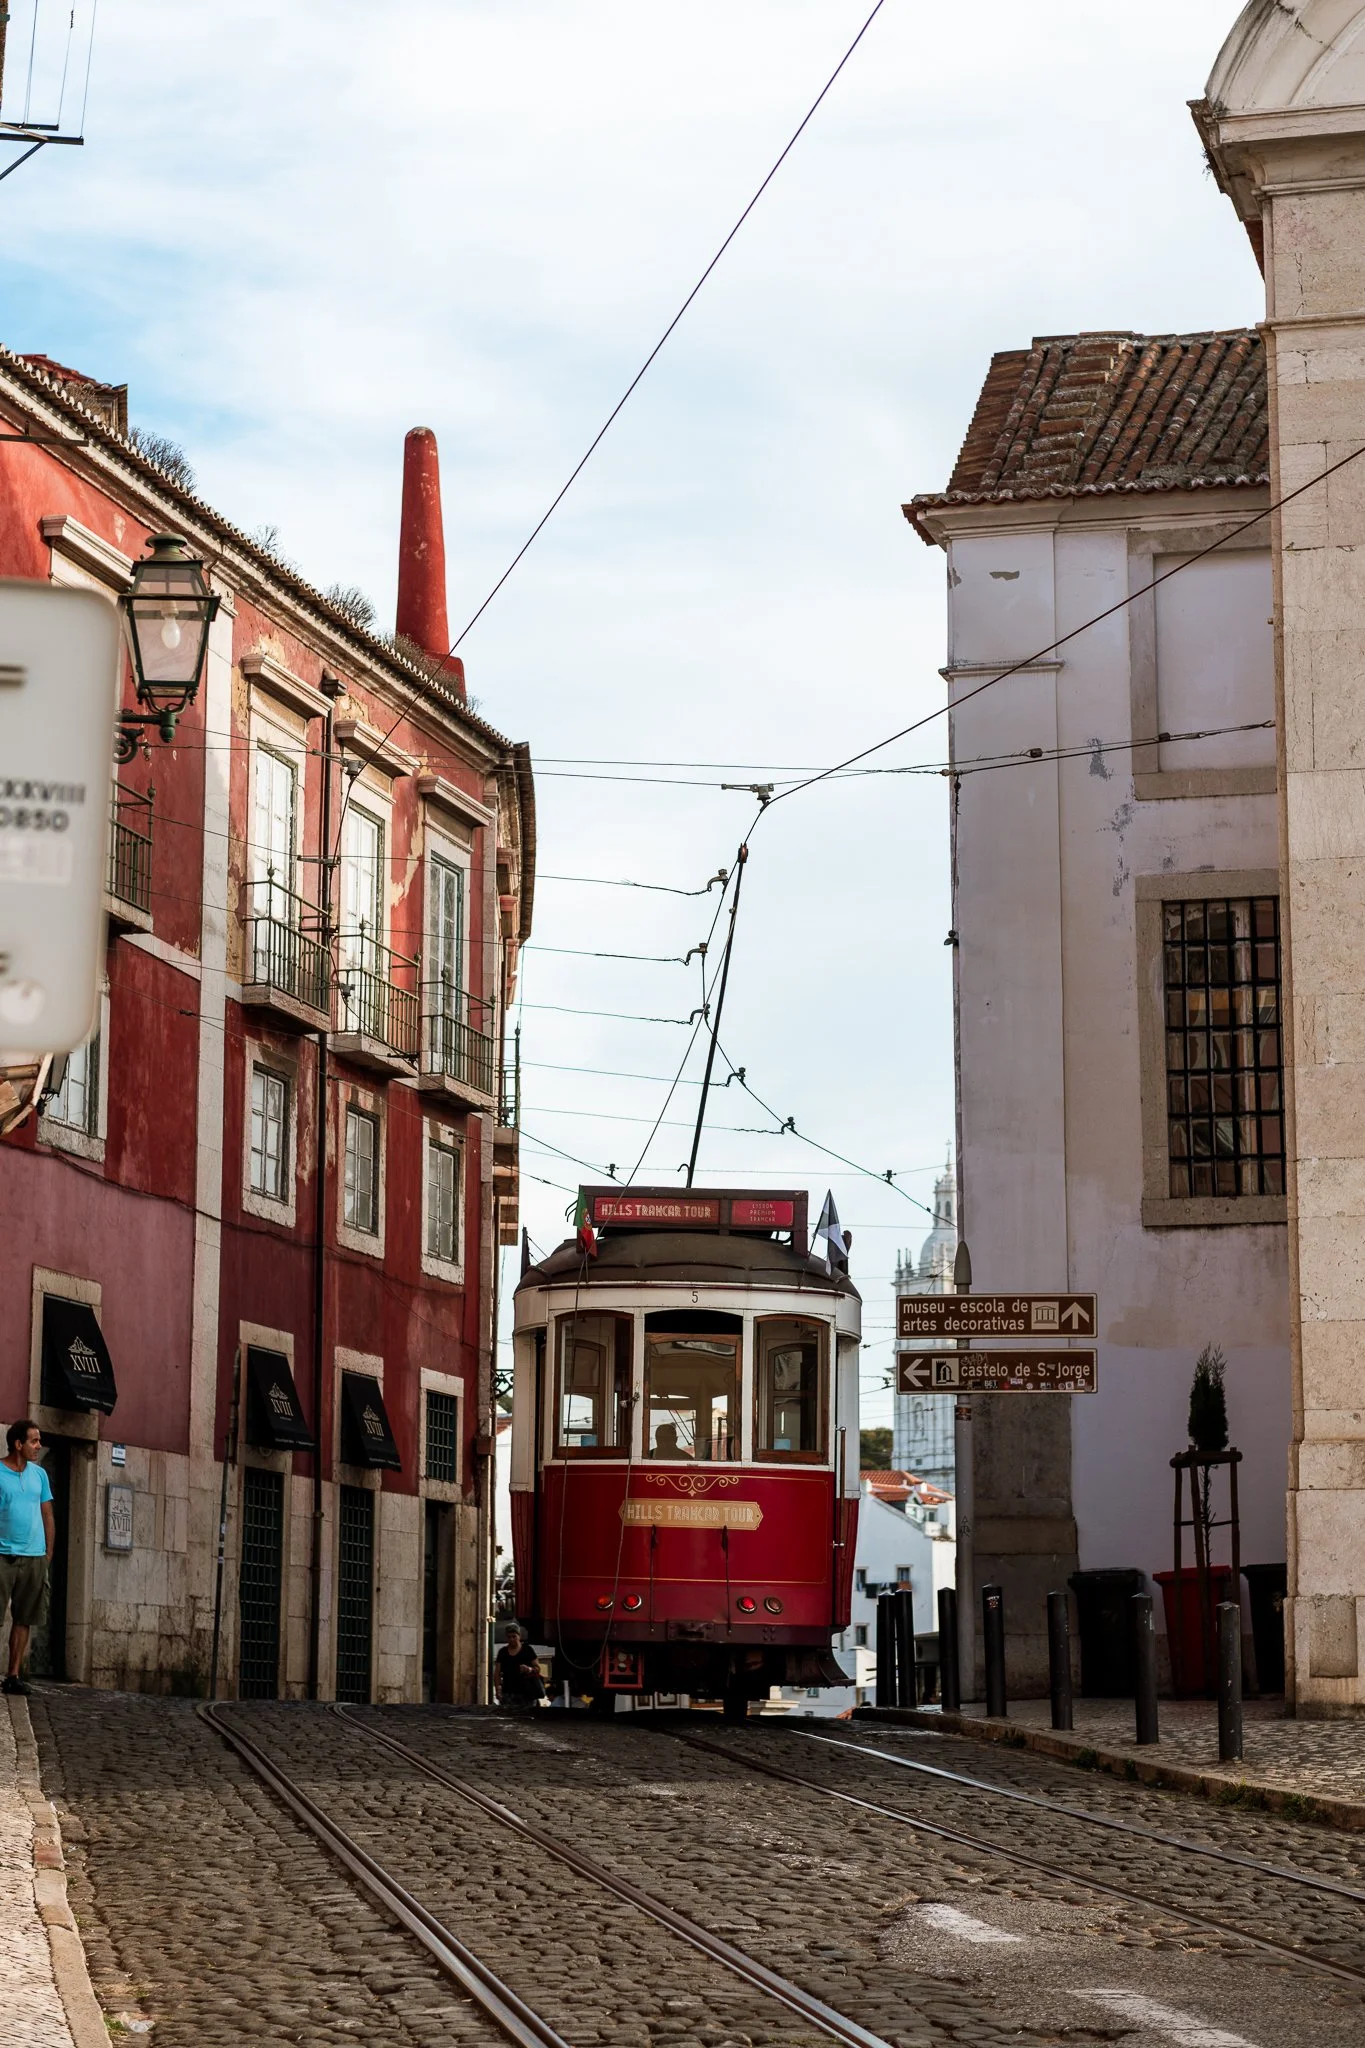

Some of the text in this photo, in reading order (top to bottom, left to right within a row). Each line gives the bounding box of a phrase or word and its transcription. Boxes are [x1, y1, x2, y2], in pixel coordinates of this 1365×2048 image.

[601, 1203, 711, 1219] HILLS TRAMCAR TOUR
[691, 1290, 699, 1304] 5
[903, 1301, 945, 1314] museu
[960, 1299, 1005, 1313] escola
[1012, 1299, 1028, 1313] de
[903, 1317, 1025, 1331] artes decorativas
[69, 1353, 102, 1374] XVIII
[961, 1363, 1008, 1378] castelo
[1015, 1362, 1031, 1377] de
[1056, 1363, 1091, 1379] Jorge
[270, 1397, 294, 1417] XVIII
[627, 1504, 754, 1522] HILLS TRAMCAR TOUR
[110, 1514, 131, 1532] XVIII
